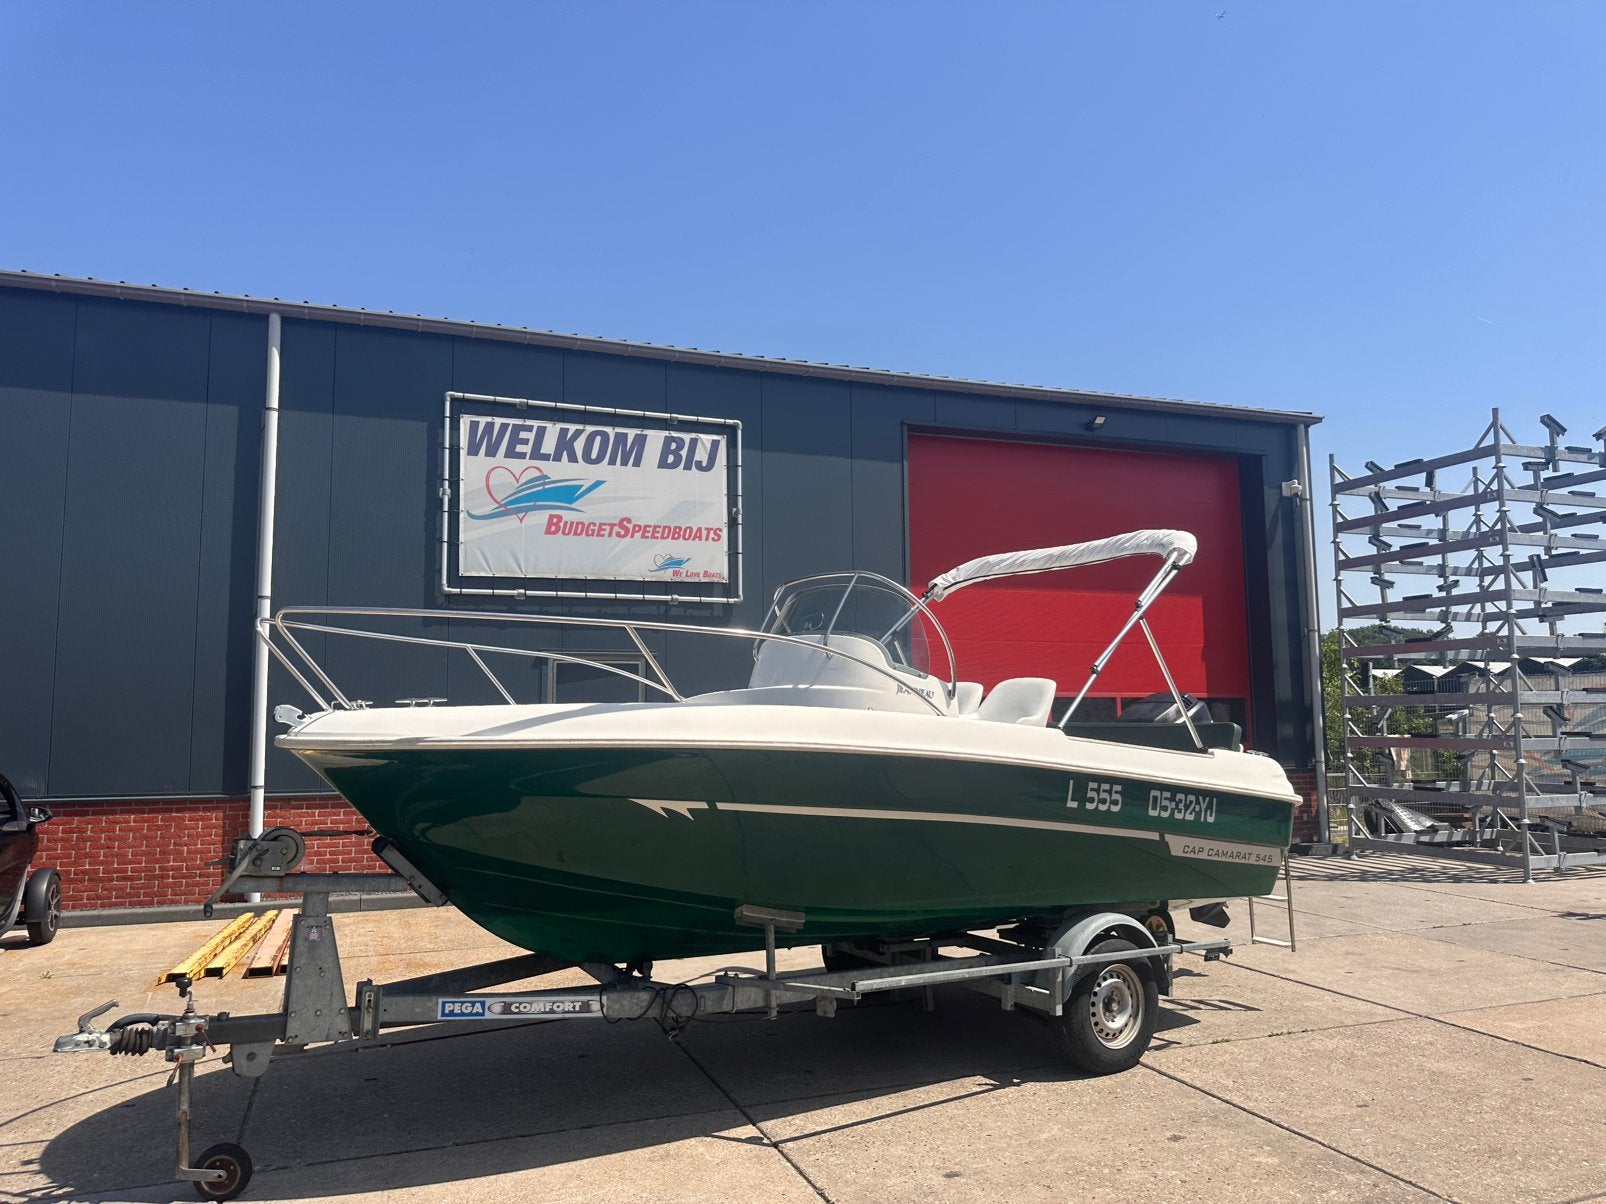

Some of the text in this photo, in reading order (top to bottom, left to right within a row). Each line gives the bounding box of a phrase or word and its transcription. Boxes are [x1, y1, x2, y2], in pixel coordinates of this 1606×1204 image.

[466, 420, 721, 472] WELKOM BIJ
[1066, 780, 1122, 812] L 555
[1148, 790, 1216, 823] 05-32-YJ
[1182, 845, 1273, 863] CAP CAMARAT 545
[444, 1001, 582, 1014] PEGA COMFORT
